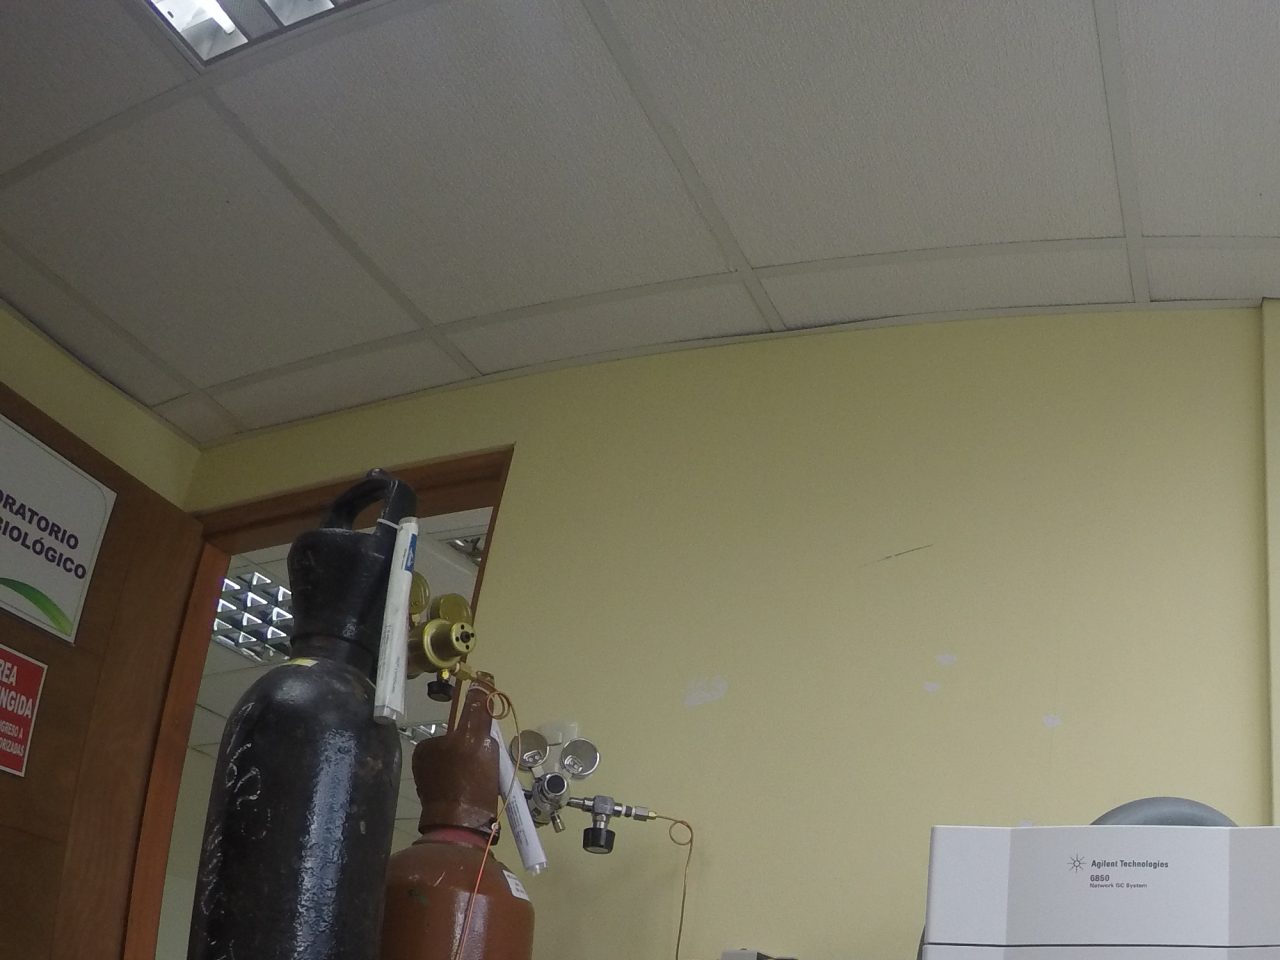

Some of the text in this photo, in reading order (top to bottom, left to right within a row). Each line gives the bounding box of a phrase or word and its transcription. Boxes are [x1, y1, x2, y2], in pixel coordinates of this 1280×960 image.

[0, 516, 87, 579] IOLÓGICO
[1091, 860, 1169, 869] Agilent Technologies
[1090, 874, 1110, 882] 6850
